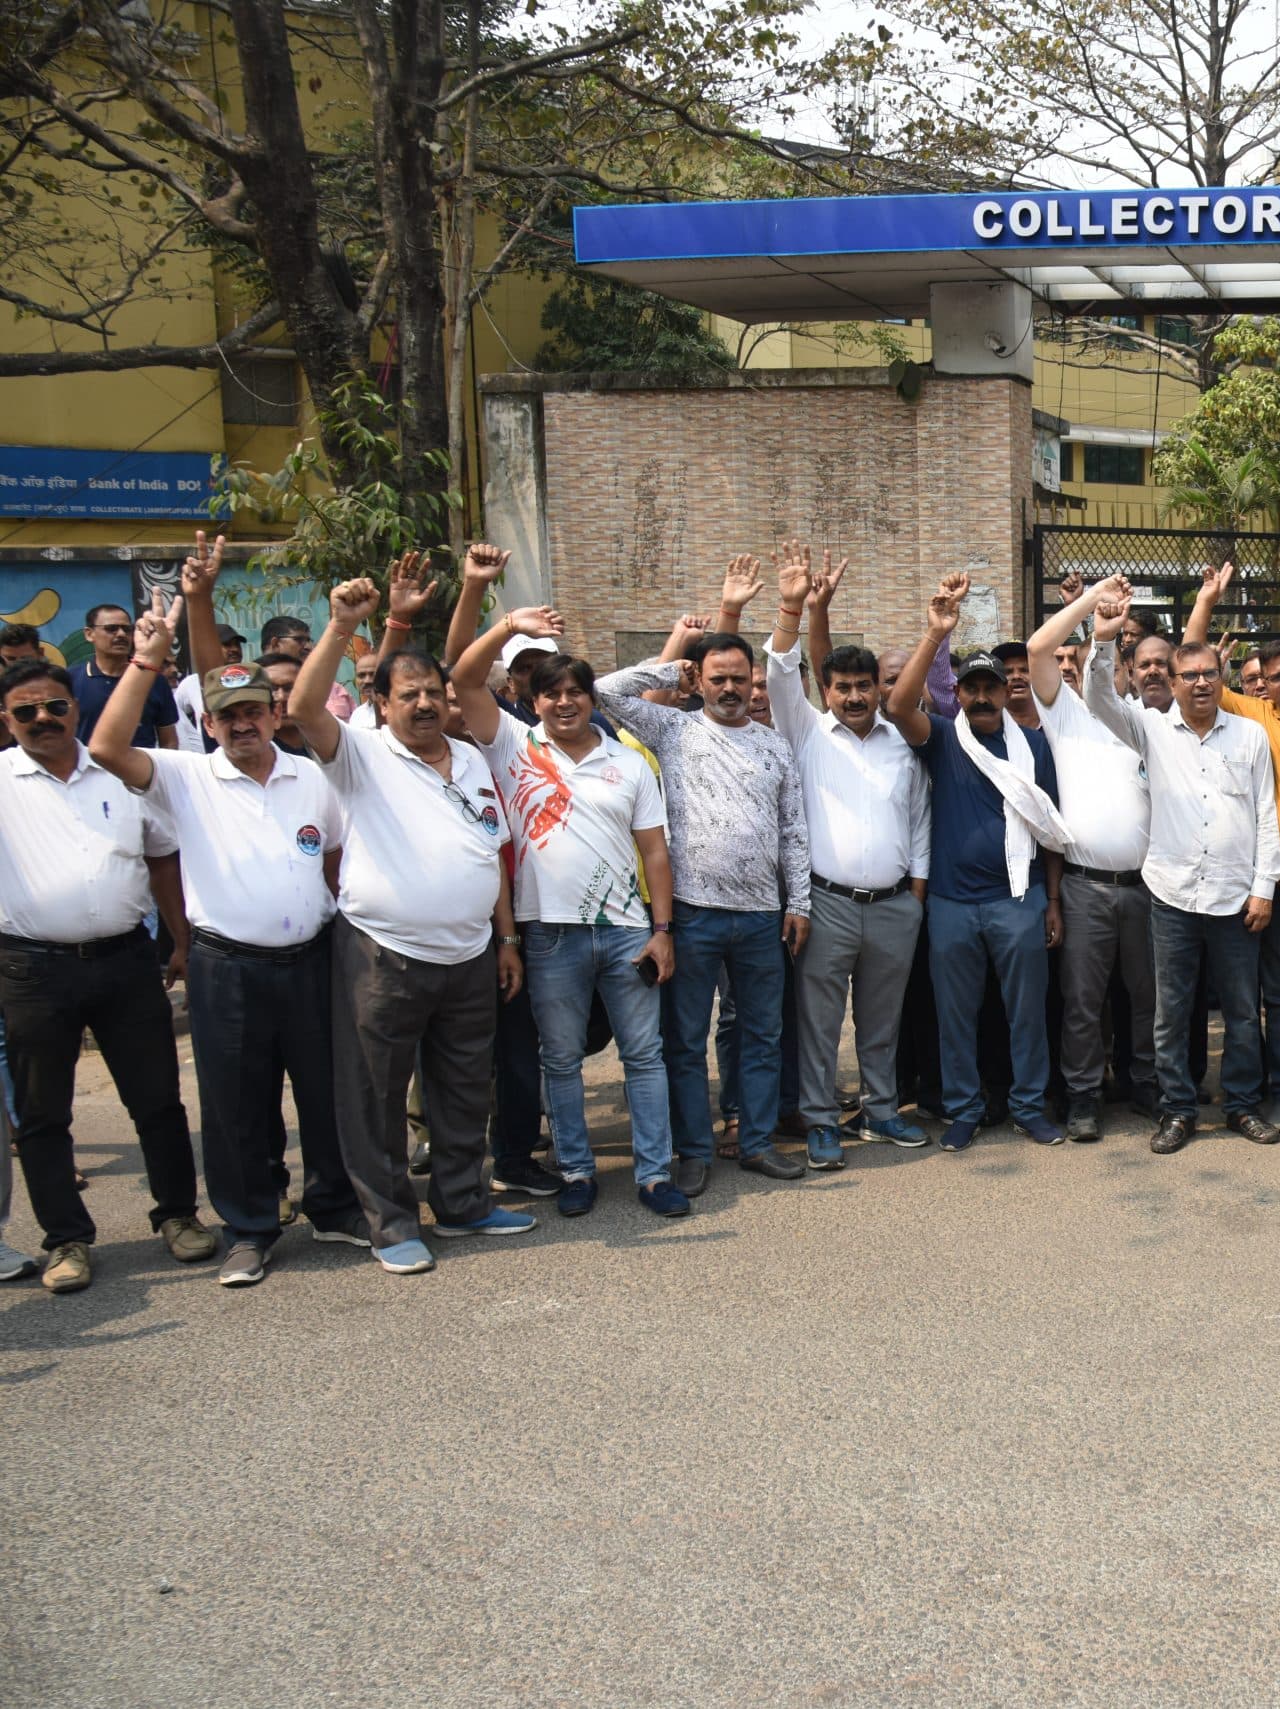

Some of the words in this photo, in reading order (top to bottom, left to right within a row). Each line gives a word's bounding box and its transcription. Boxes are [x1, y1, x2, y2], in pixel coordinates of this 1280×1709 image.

[88, 478, 120, 489] Bank
[122, 479, 136, 490] of
[138, 480, 169, 491] India
